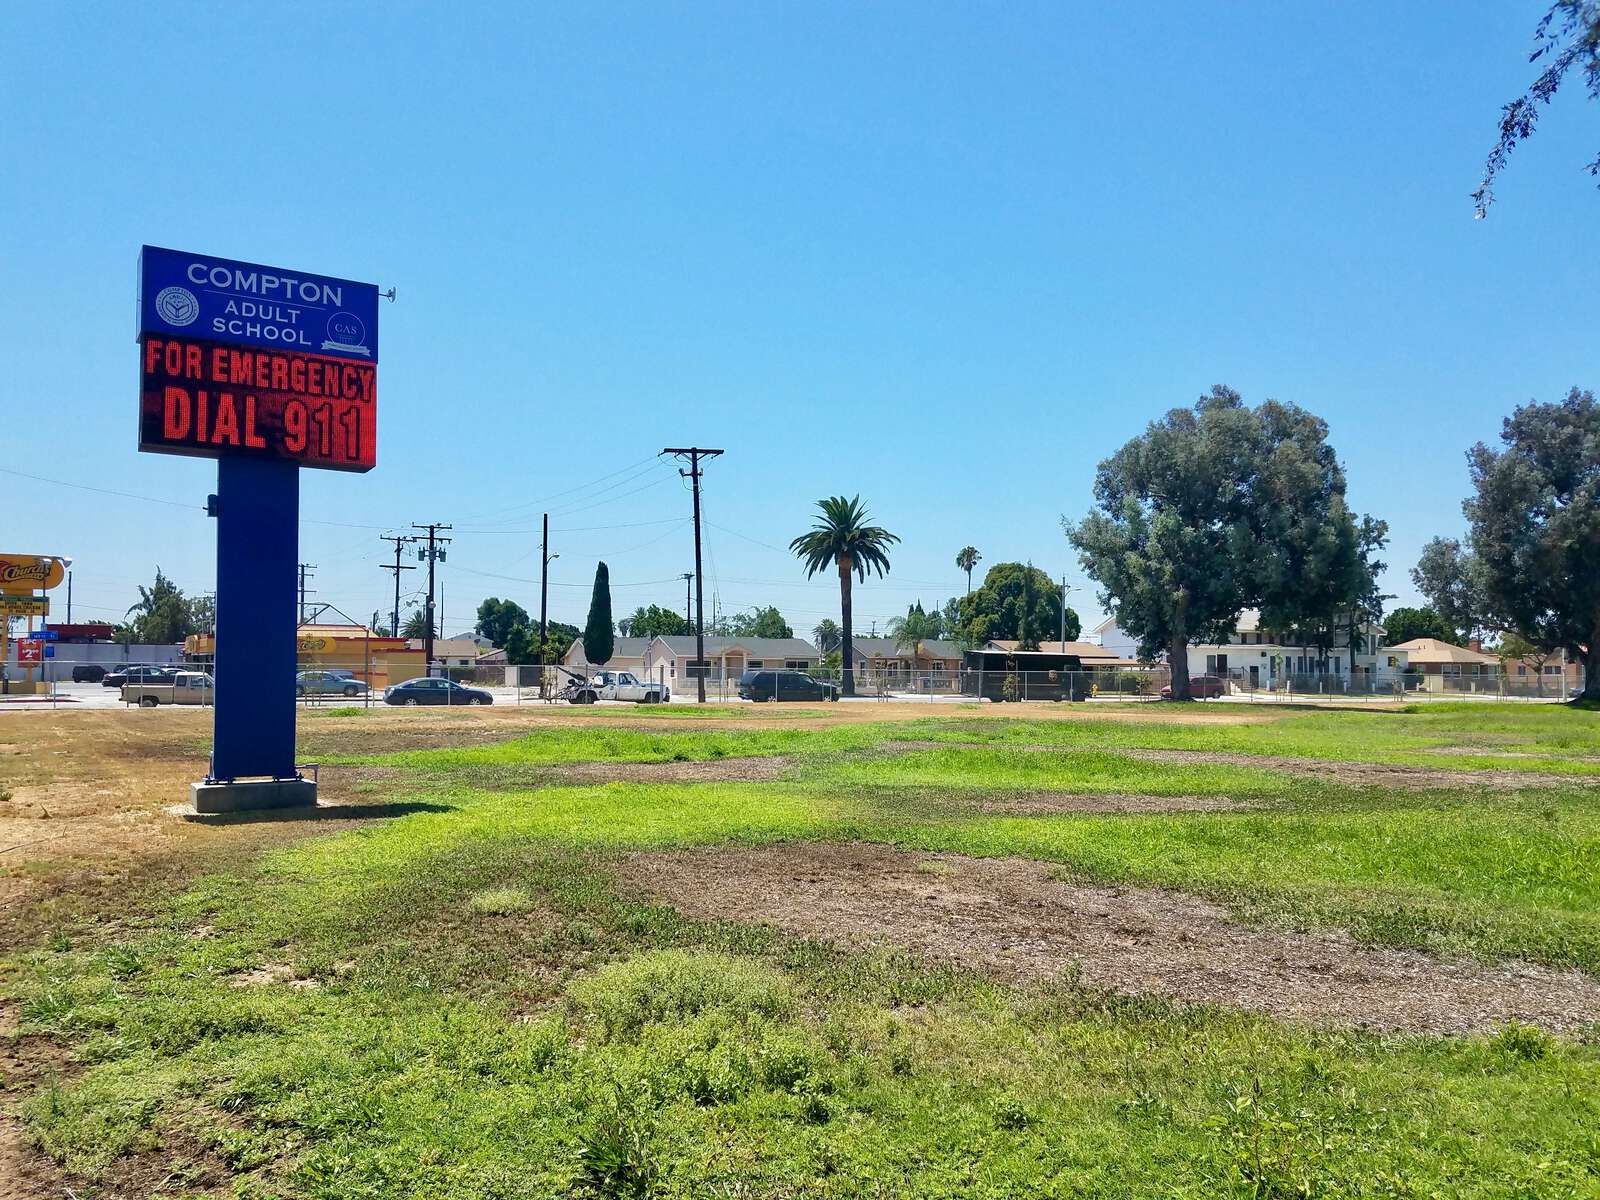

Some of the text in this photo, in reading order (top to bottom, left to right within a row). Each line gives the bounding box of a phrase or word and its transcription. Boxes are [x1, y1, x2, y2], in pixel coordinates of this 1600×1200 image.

[187, 263, 342, 307] COMPTON
[224, 300, 301, 324] ADULT
[335, 323, 358, 335] CAS
[213, 318, 312, 346] SCHOOL
[145, 339, 375, 403] FOR EMERGENCY
[164, 386, 360, 460] DIAL 911
